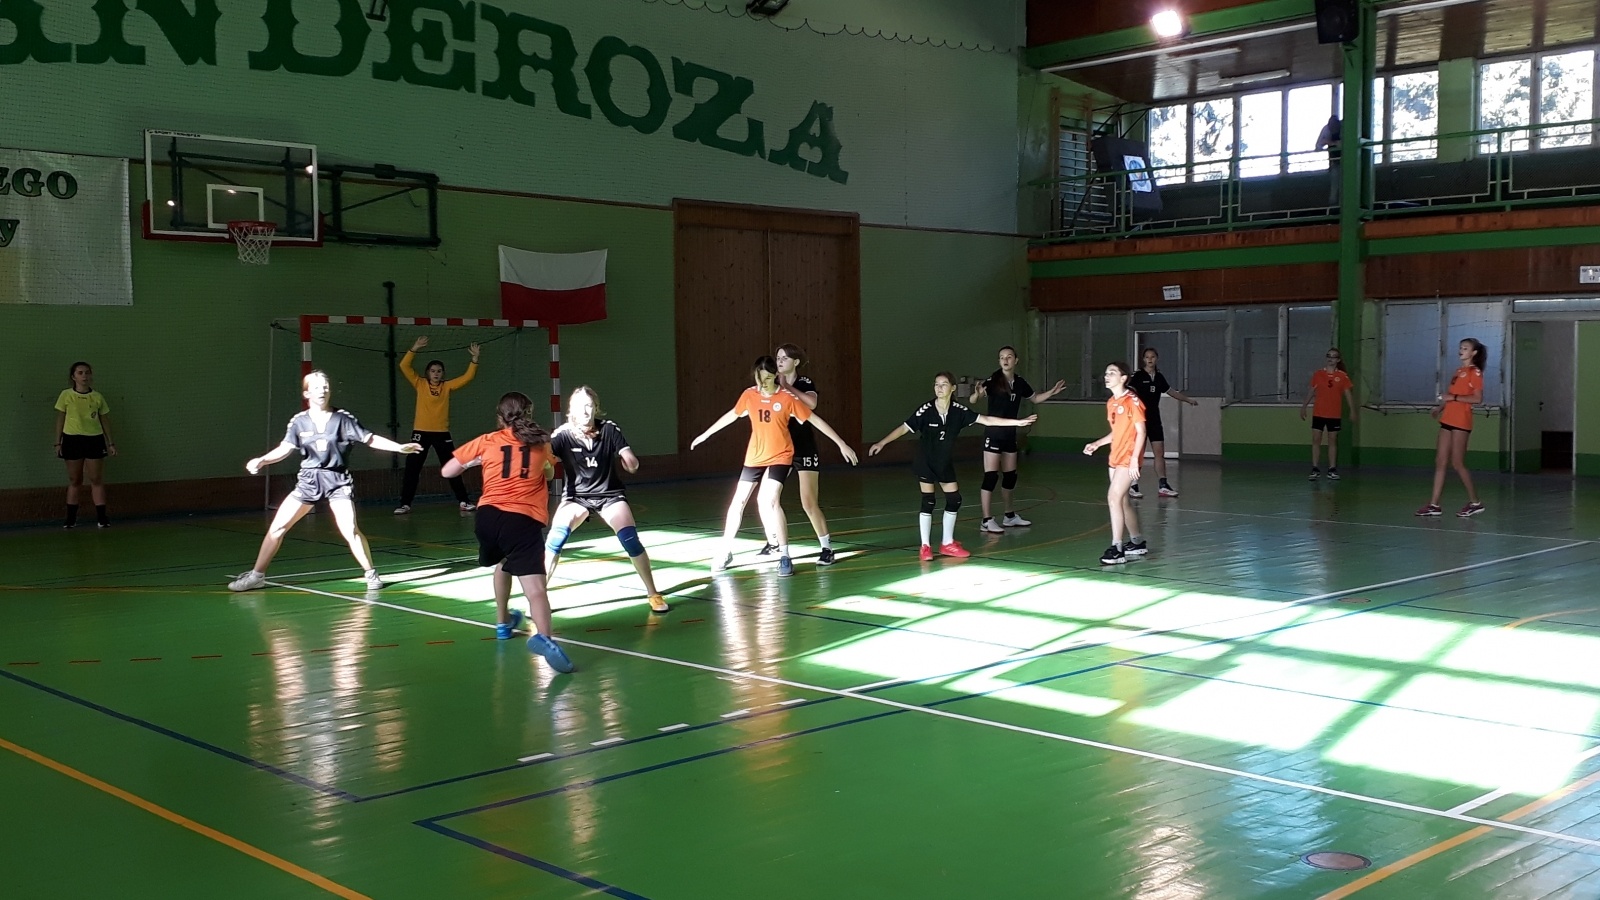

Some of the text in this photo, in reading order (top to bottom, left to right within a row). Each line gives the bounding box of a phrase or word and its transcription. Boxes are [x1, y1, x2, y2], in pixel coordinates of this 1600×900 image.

[758, 408, 771, 423] 18
[412, 433, 421, 442] 33
[939, 430, 946, 440] 2
[500, 444, 531, 479] 11
[585, 456, 598, 468] 14
[802, 456, 812, 467] 15
